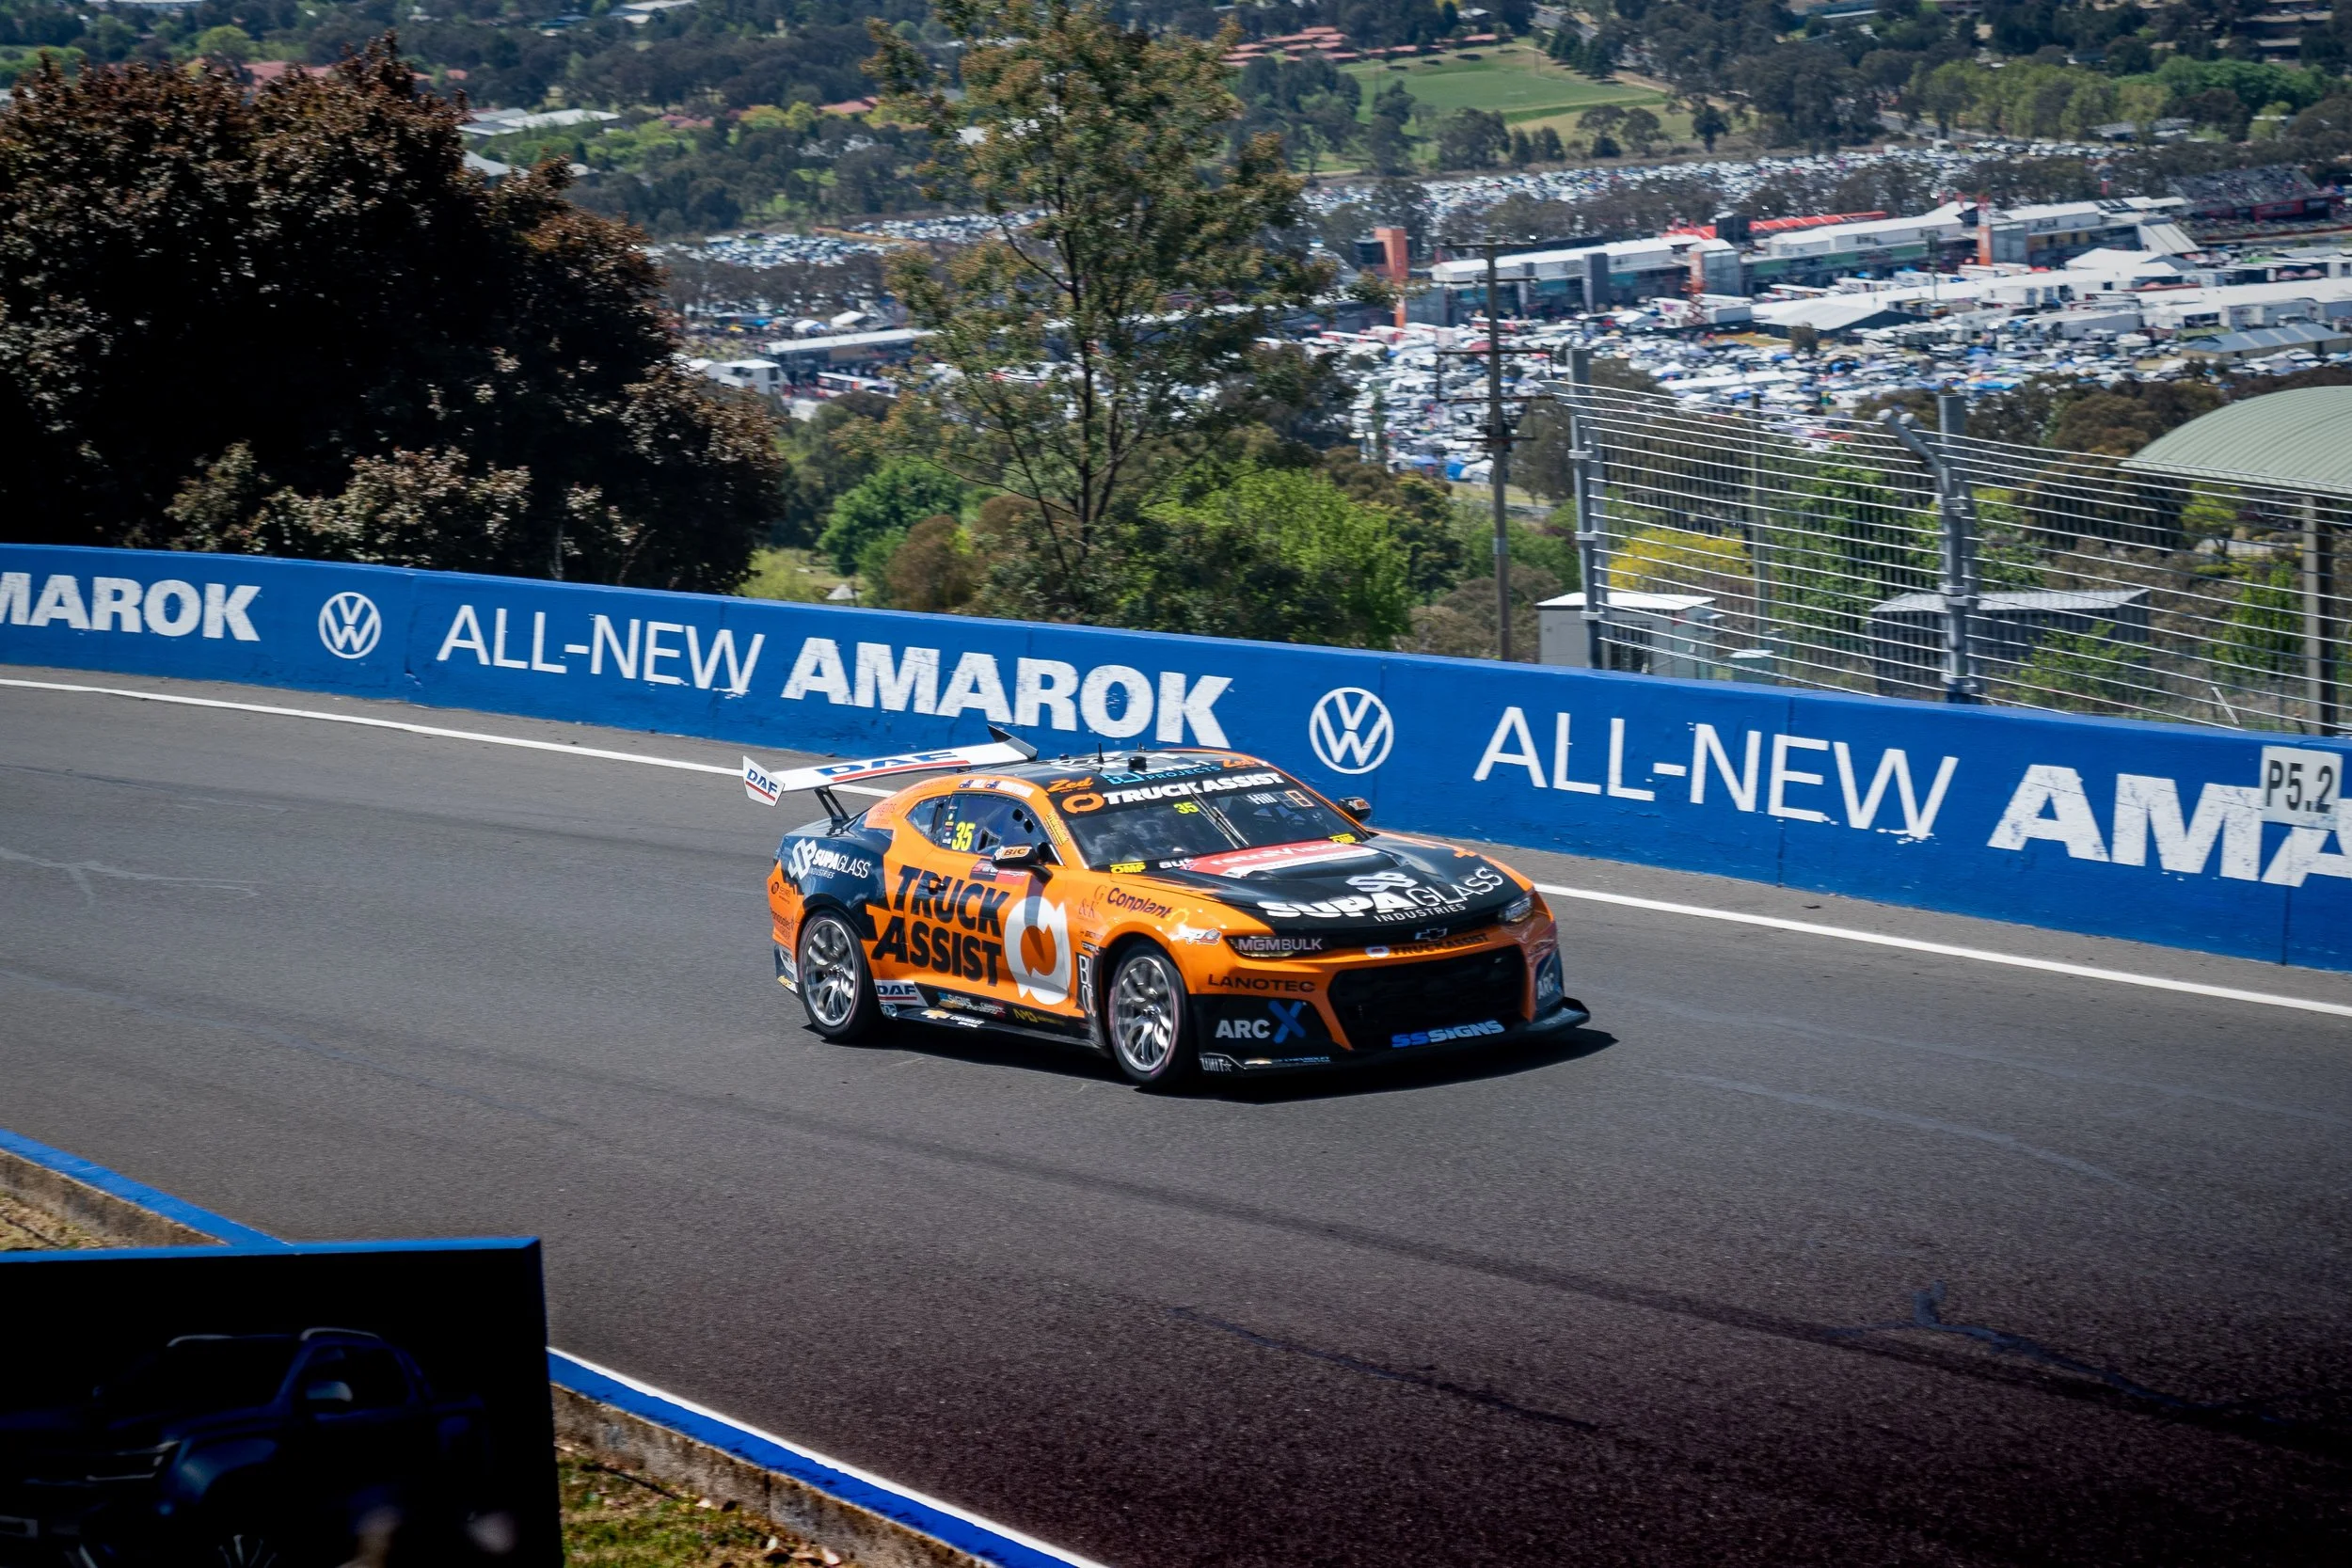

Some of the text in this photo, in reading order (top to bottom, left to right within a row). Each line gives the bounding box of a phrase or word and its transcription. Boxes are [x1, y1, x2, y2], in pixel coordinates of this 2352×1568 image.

[436, 604, 1234, 749] ALL-NEW AMAROK
[815, 751, 959, 777] DAF
[1147, 766, 1222, 782] PROJECTS
[1473, 705, 1959, 841] ALL-NEW
[746, 767, 778, 796] DAF
[2265, 758, 2334, 815] P5.2
[1172, 800, 1200, 815] 35
[1246, 792, 1279, 805] Hill
[951, 820, 977, 852] 35
[812, 847, 871, 879] SUPAGLASS
[1003, 847, 1026, 857] BIC
[1110, 863, 1146, 874] OMP
[893, 864, 1010, 938] TRUCK
[1106, 887, 1174, 919] Conplant
[1257, 865, 1505, 918] SUPAGLASS
[1373, 903, 1467, 923] INDUSTRIES
[870, 915, 1003, 988] ASSIST
[1237, 938, 1323, 951] MGMBULK
[876, 984, 917, 996] DAF
[1208, 974, 1316, 993] LANOTEC
